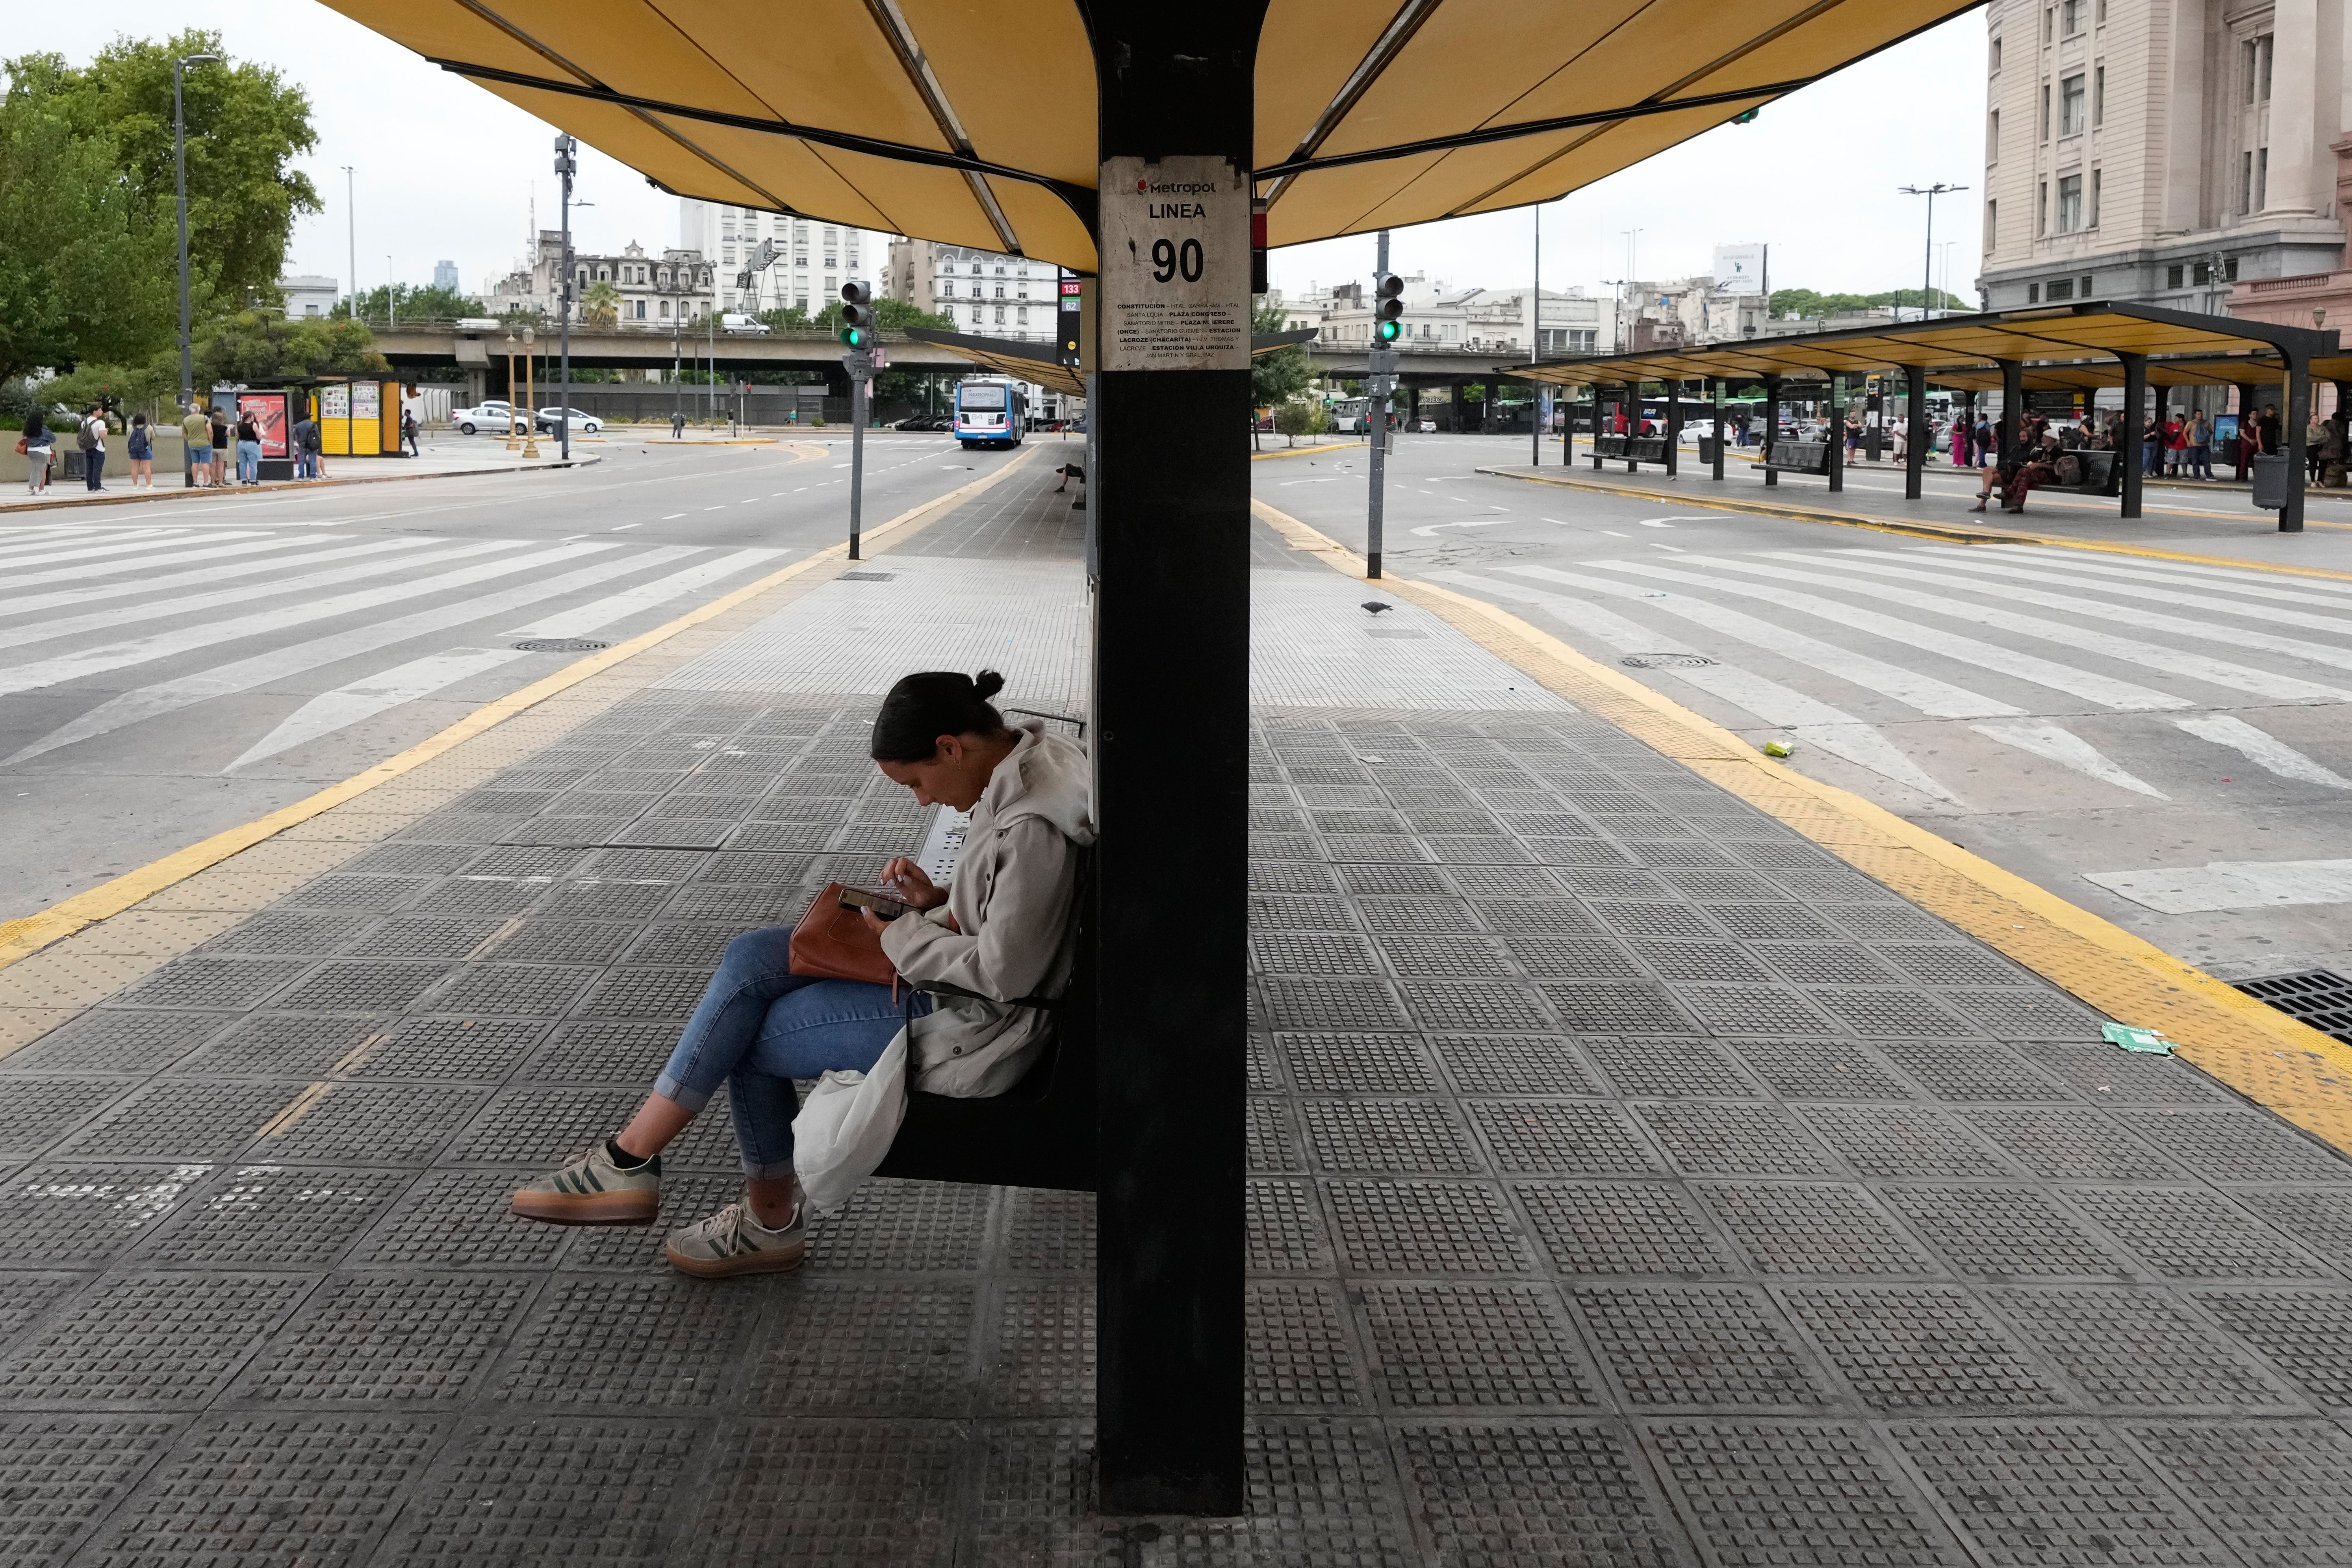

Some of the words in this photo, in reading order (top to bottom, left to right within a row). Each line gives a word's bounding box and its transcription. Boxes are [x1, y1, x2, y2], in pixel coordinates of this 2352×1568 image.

[1150, 183, 1216, 196] Metropol
[1150, 204, 1206, 218] LINEA
[1152, 238, 1204, 283] 90
[1064, 285, 1079, 293] 133
[1066, 302, 1076, 310] 62
